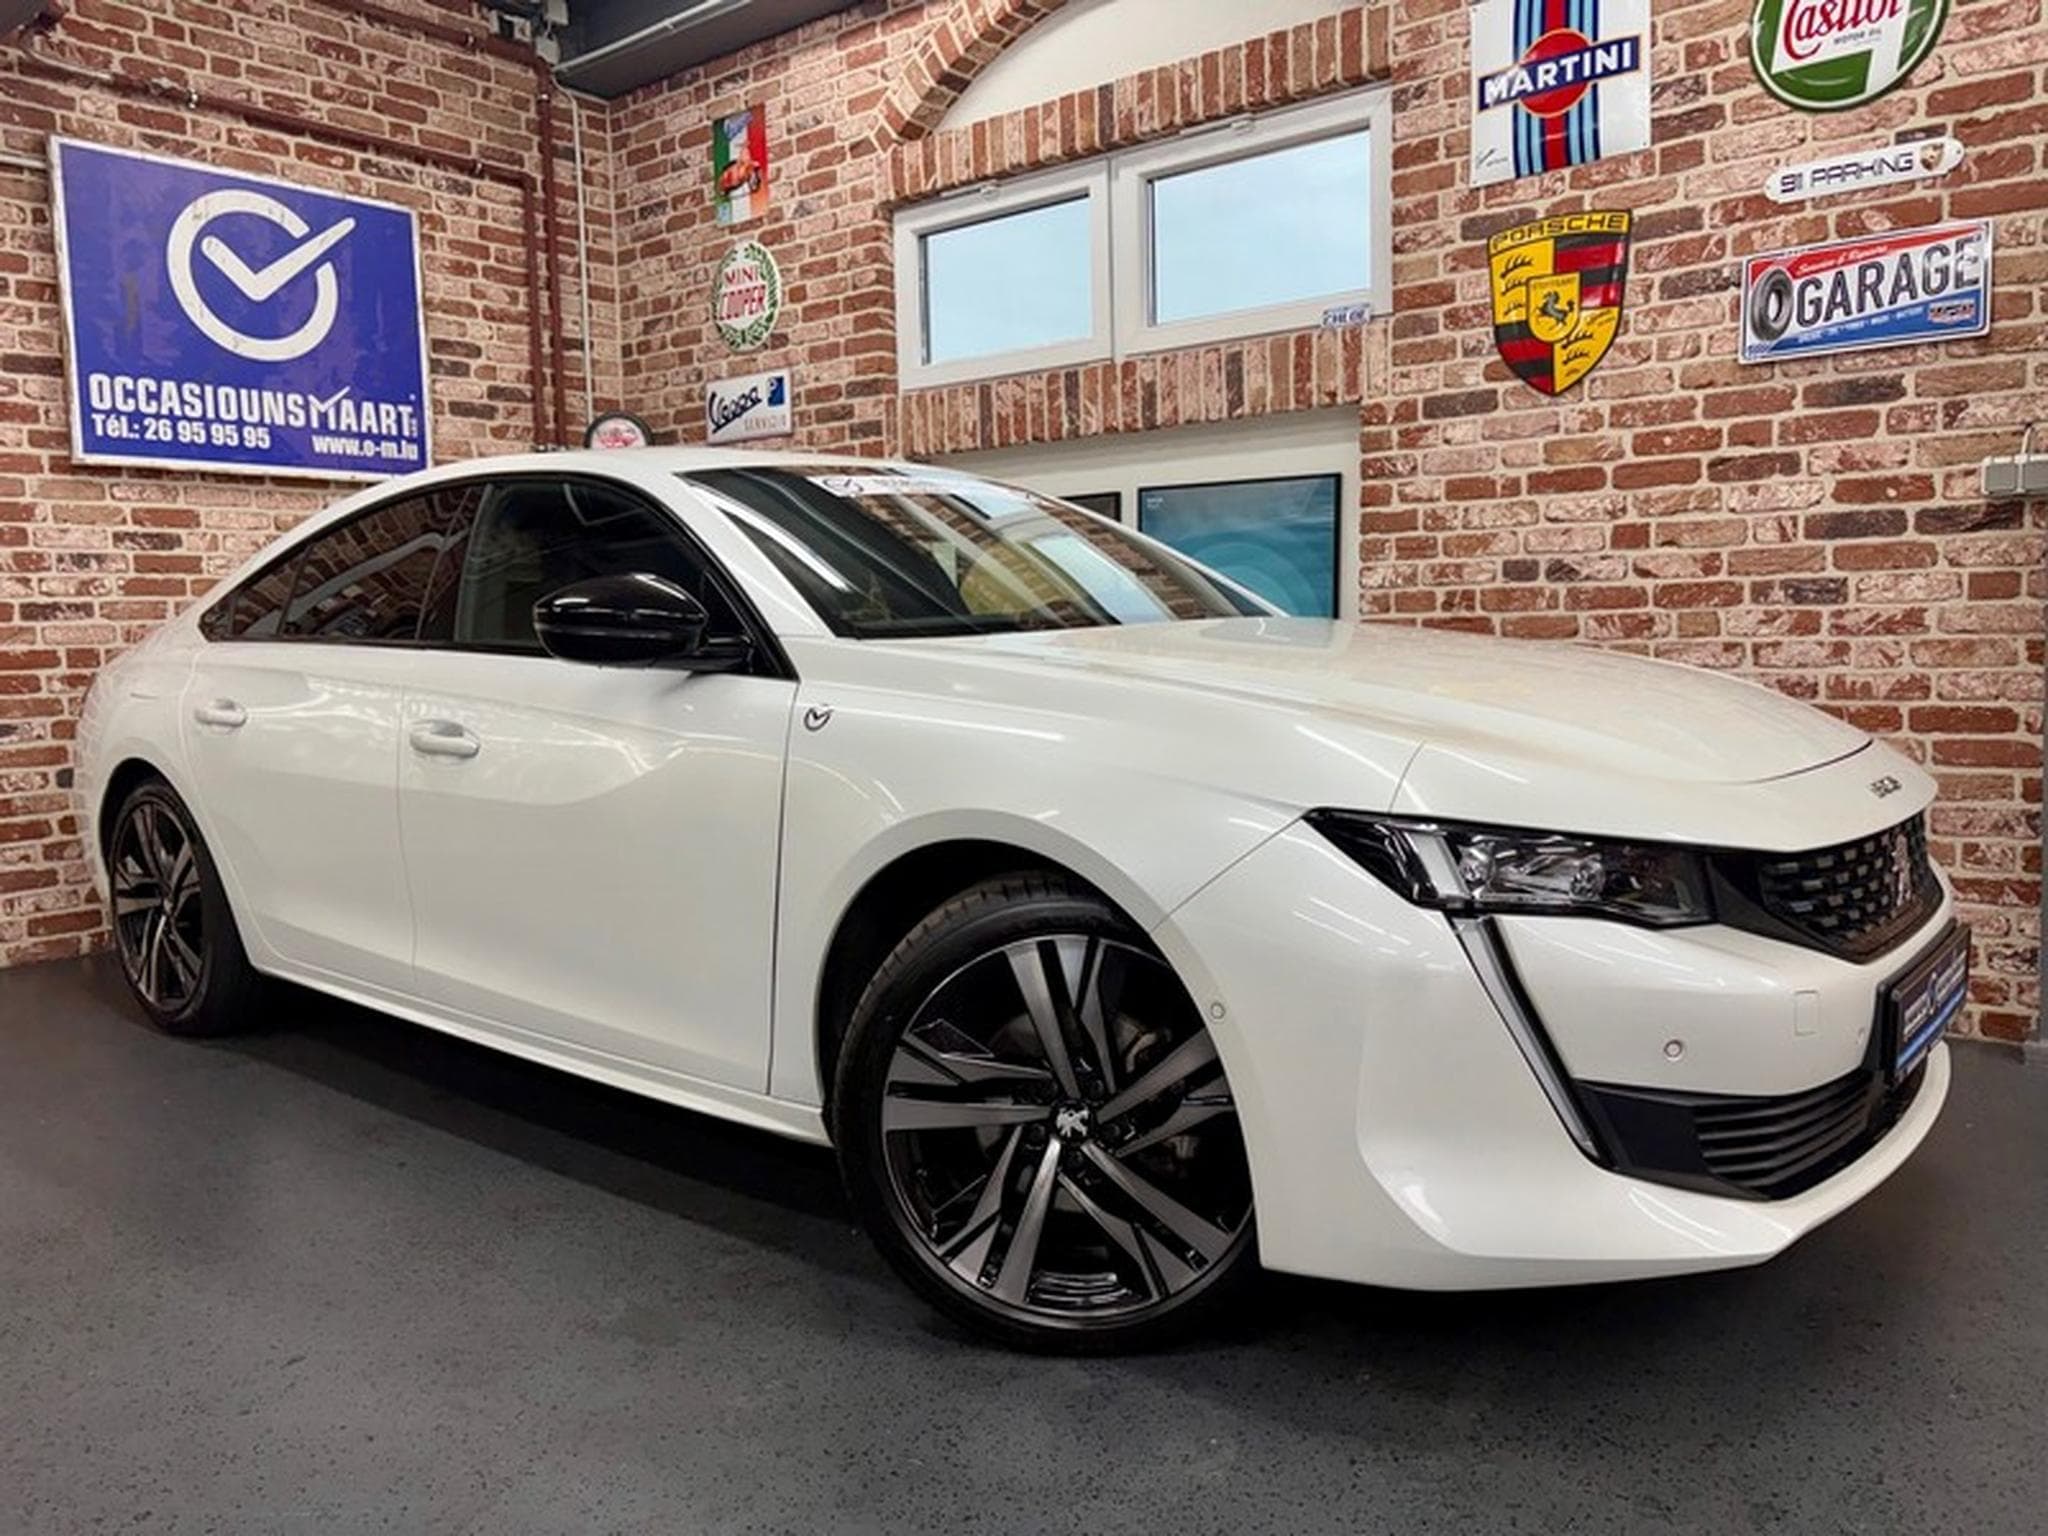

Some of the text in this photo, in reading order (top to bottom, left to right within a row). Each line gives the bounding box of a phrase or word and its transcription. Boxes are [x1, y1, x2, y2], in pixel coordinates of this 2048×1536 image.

[1783, 0, 1903, 60] Castro
[1484, 41, 1632, 104] MARTINI
[1811, 152, 1914, 188] PARKING
[1493, 213, 1626, 250] PORSCHE
[724, 264, 759, 284] MINI
[1796, 235, 1981, 328] GARAGE
[709, 386, 763, 434] Vespa
[91, 412, 270, 450] Tél.: 26 95 95 95
[311, 435, 419, 461] www.o-m.lu
